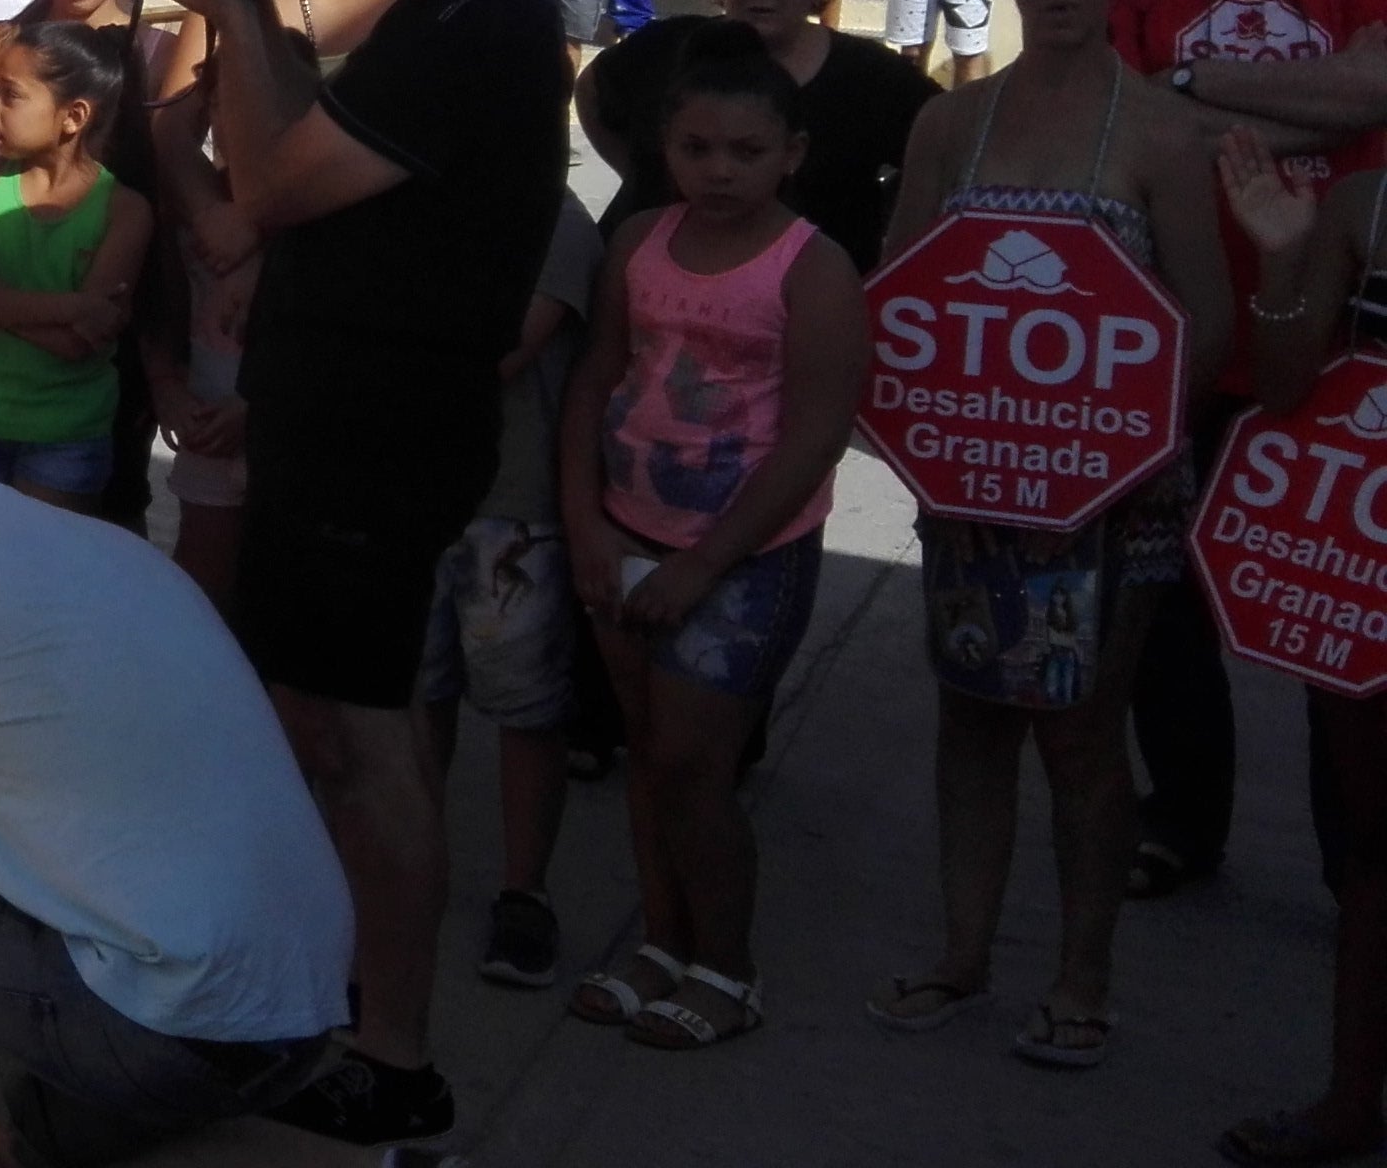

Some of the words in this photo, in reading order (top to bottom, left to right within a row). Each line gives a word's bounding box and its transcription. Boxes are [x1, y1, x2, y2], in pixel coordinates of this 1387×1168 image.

[874, 295, 1162, 391] STOP
[872, 373, 1152, 439] Desahucios
[904, 421, 1110, 481] Granada
[959, 470, 1004, 504] 15
[1014, 476, 1050, 510] M
[1232, 431, 1387, 546] ST
[1212, 506, 1387, 594] Desahu
[1228, 560, 1387, 640] Granad
[1267, 617, 1311, 655] 15
[1314, 633, 1354, 670] M
